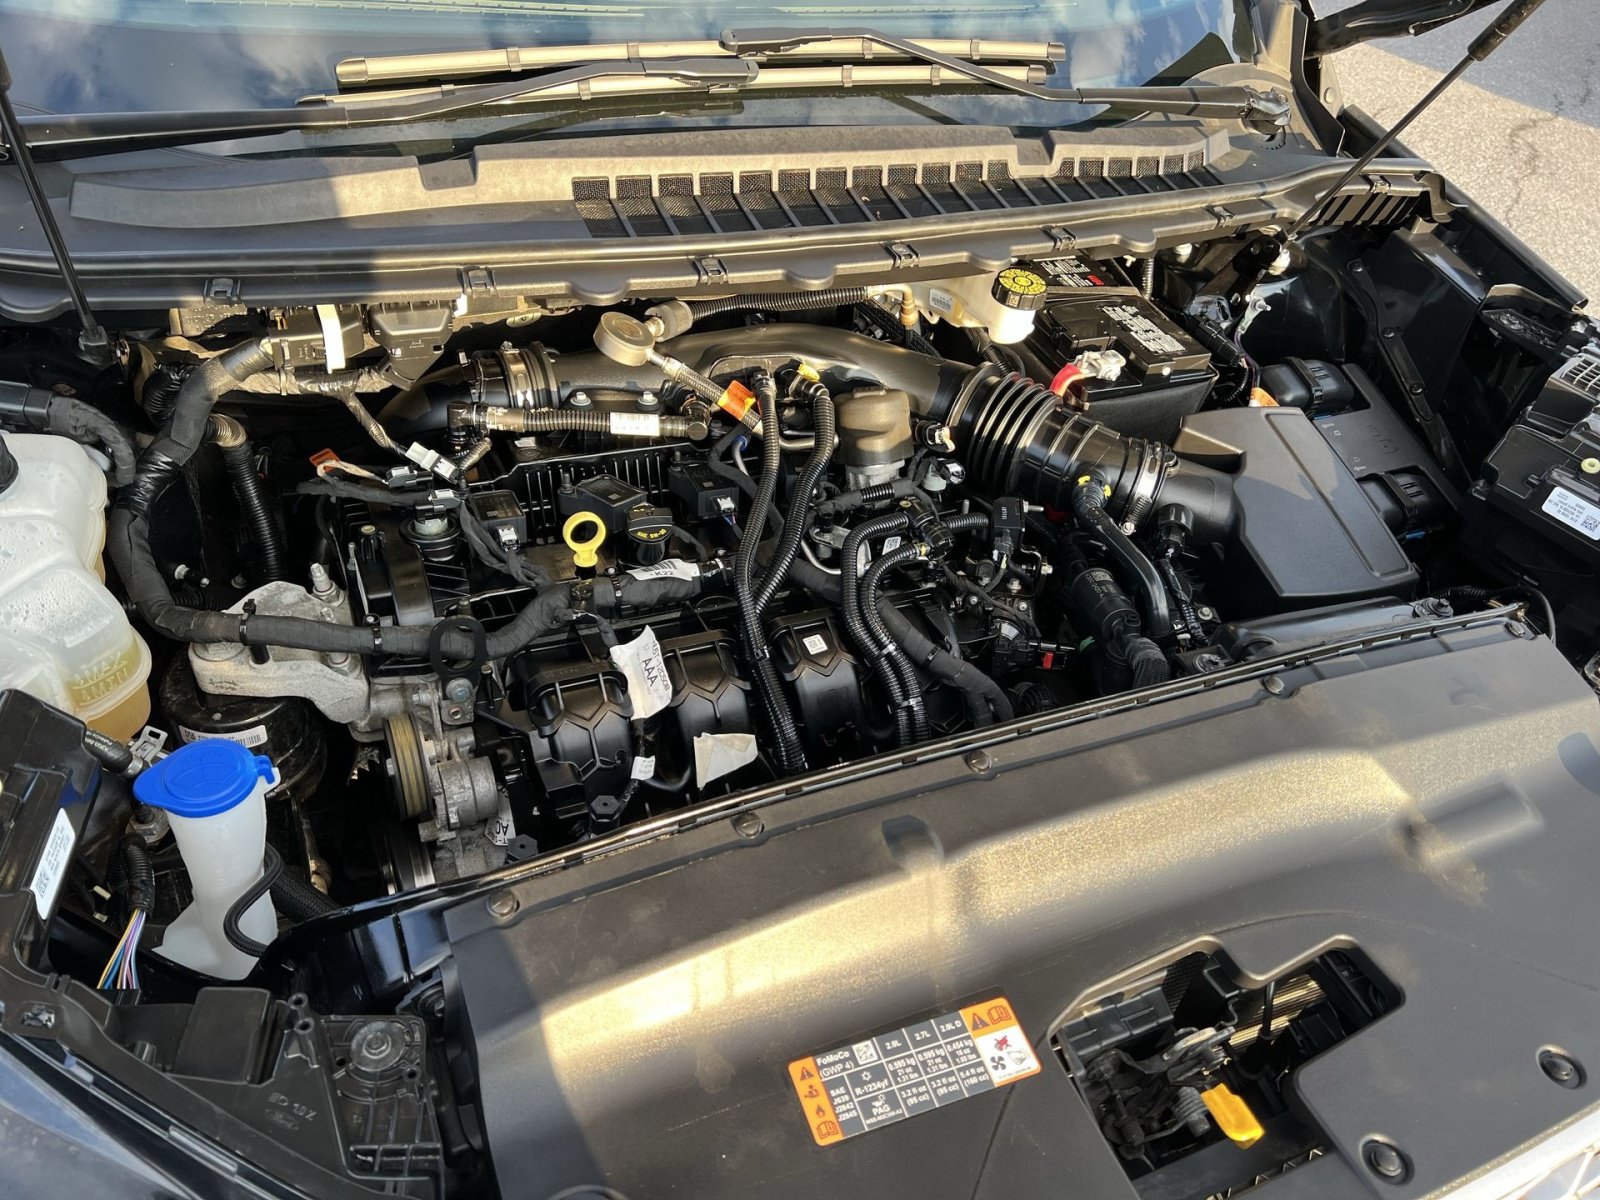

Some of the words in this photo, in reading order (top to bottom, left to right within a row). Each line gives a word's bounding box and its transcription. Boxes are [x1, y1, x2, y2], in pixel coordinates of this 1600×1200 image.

[642, 658, 658, 687] AAA
[914, 1030, 931, 1040] 2.7L
[885, 1040, 902, 1050] 2.0L
[935, 1048, 945, 1056] kg
[816, 1051, 850, 1066] FoMoCo
[906, 1058, 916, 1066] kg
[820, 1063, 843, 1078] (GWP
[844, 1060, 854, 1070] 4)
[927, 1065, 939, 1073] 1.31
[897, 1074, 910, 1082] 1.31
[978, 1072, 990, 1081] cc)
[854, 1078, 888, 1096] R-1234yf
[930, 1079, 942, 1088] 3.2
[830, 1086, 846, 1096] SAE
[901, 1088, 912, 1098] 3.2
[936, 1086, 948, 1096] (95
[948, 1082, 960, 1092] cc)
[833, 1094, 850, 1105] J639
[906, 1096, 918, 1107] (95
[918, 1092, 930, 1101] cc)
[872, 1104, 890, 1116] PAG
